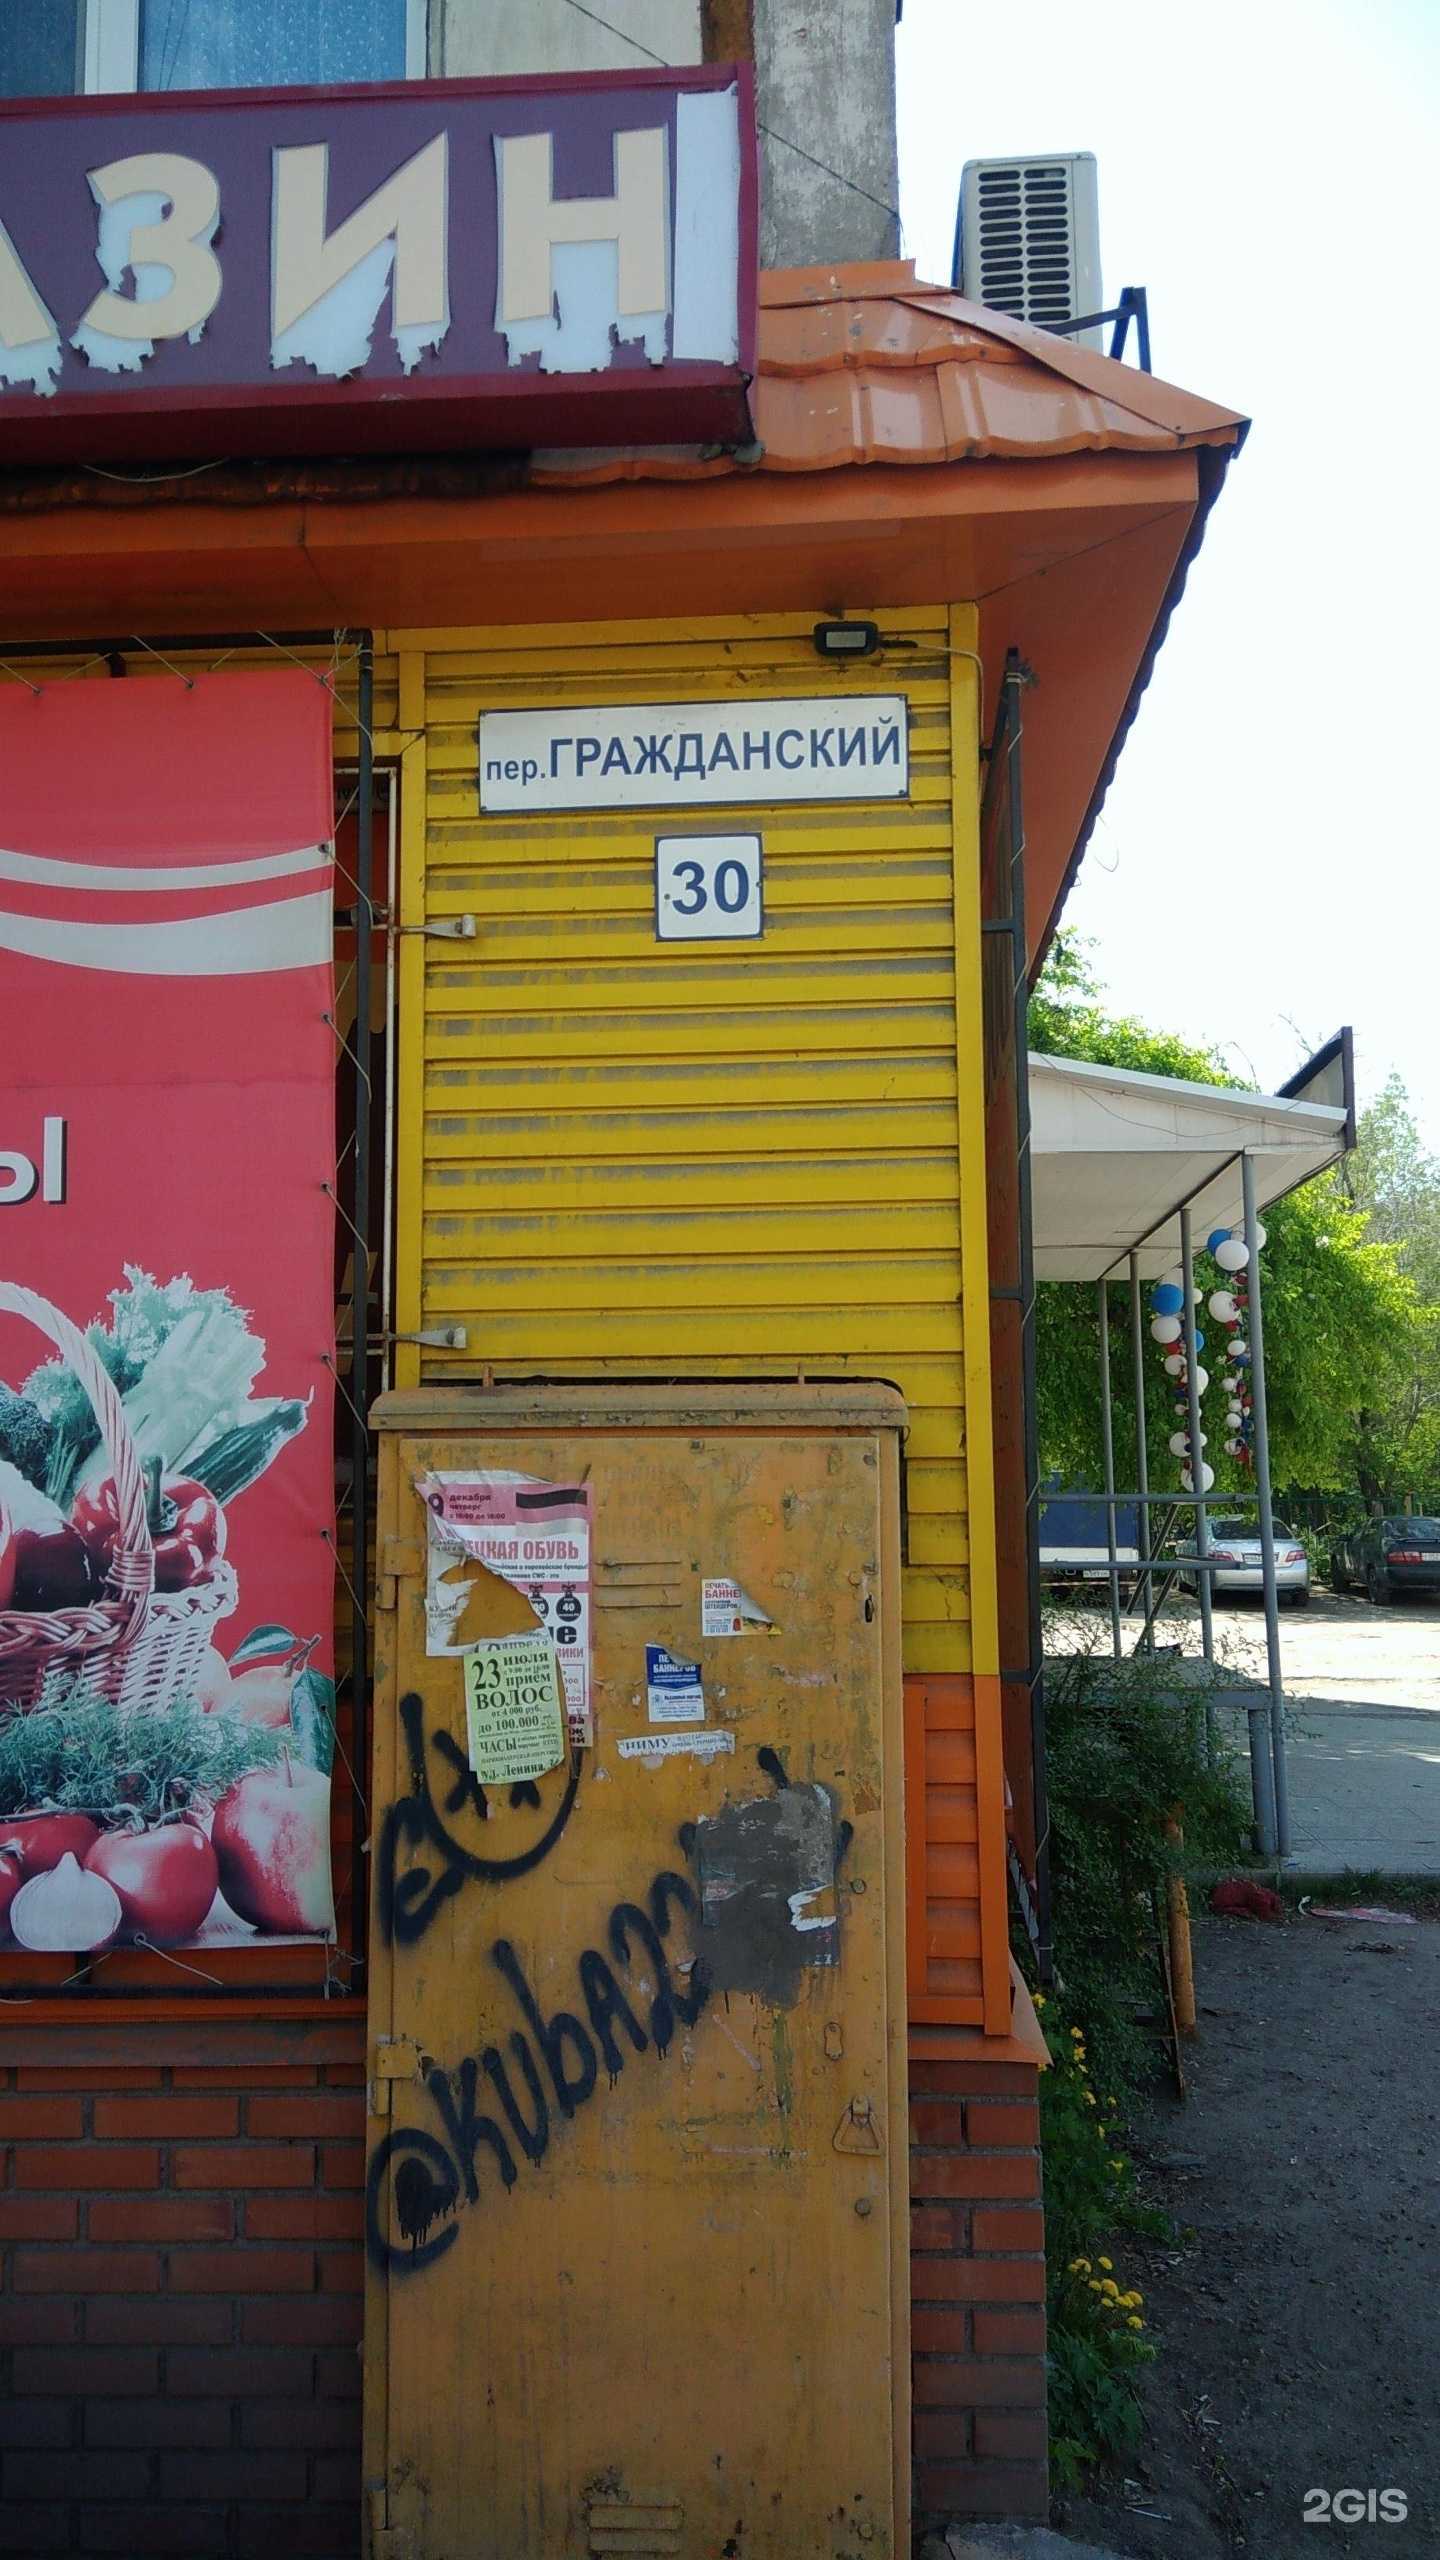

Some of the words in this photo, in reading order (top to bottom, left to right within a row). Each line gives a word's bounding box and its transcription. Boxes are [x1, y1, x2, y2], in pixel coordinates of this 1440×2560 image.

[549, 716, 901, 781] ГРАЖДАНСКИЙ
[671, 859, 750, 916] 30
[449, 1493, 491, 1502] декабря
[449, 1503, 481, 1511] четверг
[522, 1540, 580, 1561] ОБУВЬ
[472, 1658, 501, 1691] 23
[503, 1652, 549, 1666] июля
[476, 1685, 553, 1711] ВОЛОС
[479, 1724, 492, 1735] до
[495, 1715, 539, 1731] 100.000
[480, 1737, 517, 1754] ЧАСЫ
